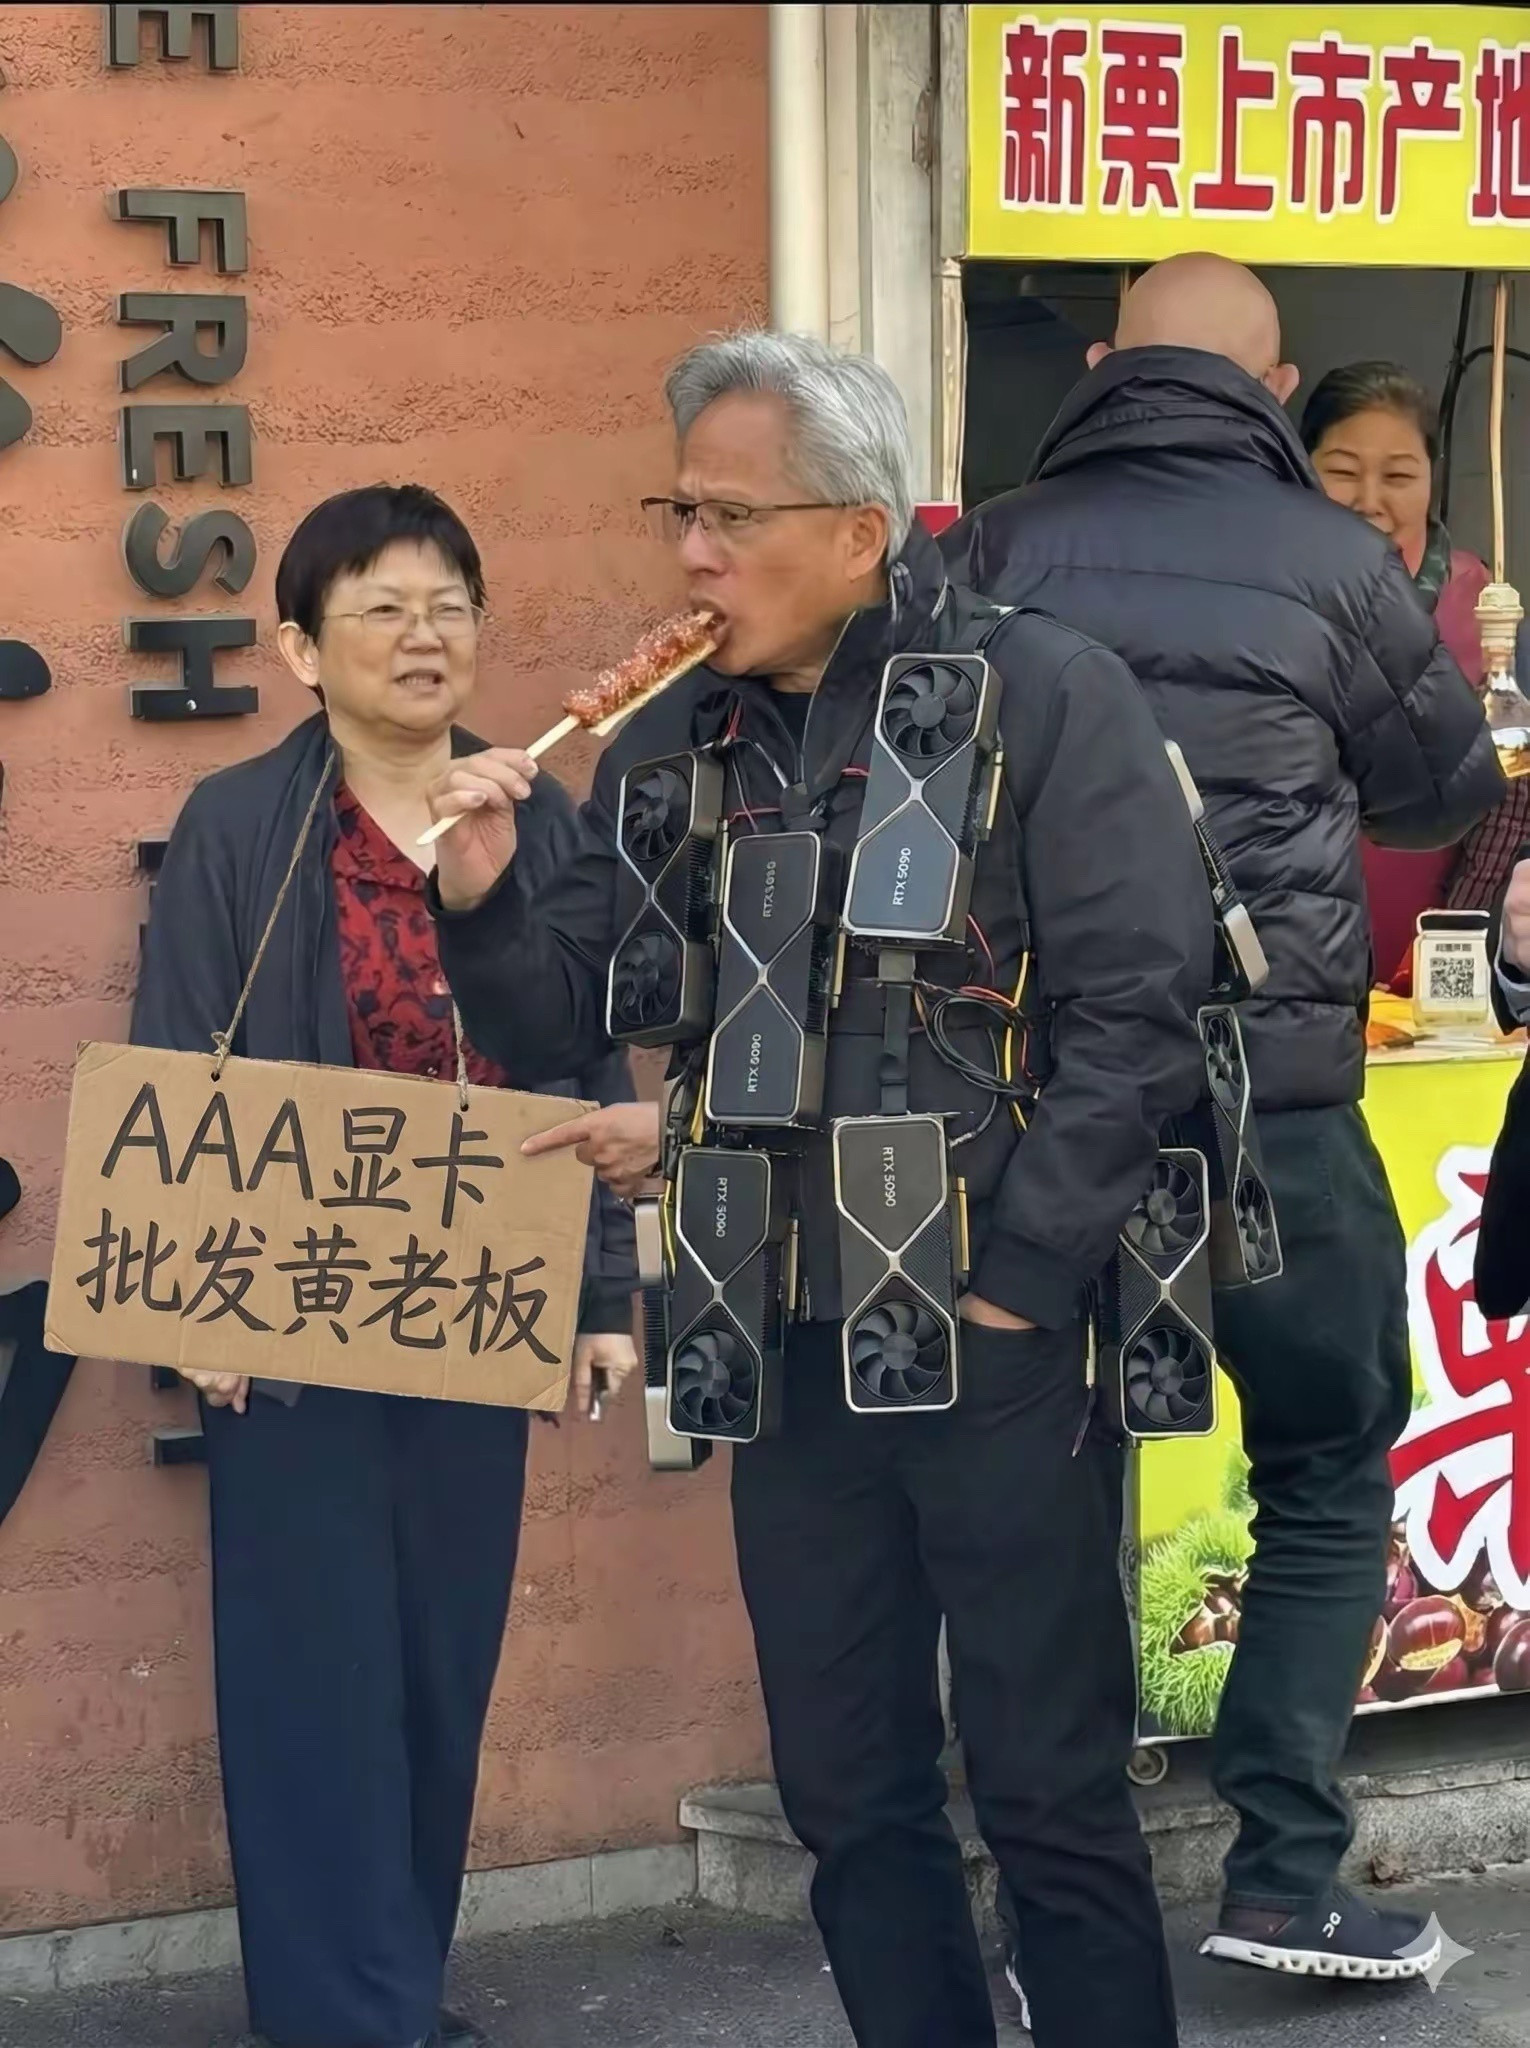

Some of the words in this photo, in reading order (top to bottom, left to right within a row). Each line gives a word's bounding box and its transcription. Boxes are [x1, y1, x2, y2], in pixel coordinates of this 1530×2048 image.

[110, 187, 259, 721] FRESH
[897, 847, 912, 879] 5090
[892, 880, 907, 906] RTX
[746, 1066, 760, 1093] RTX
[100, 1081, 505, 1229] AAA显卡
[882, 1146, 895, 1172] RTX
[717, 1177, 728, 1202] RTX
[884, 1174, 897, 1207] 5090
[75, 1207, 562, 1365] 批发黄老板
